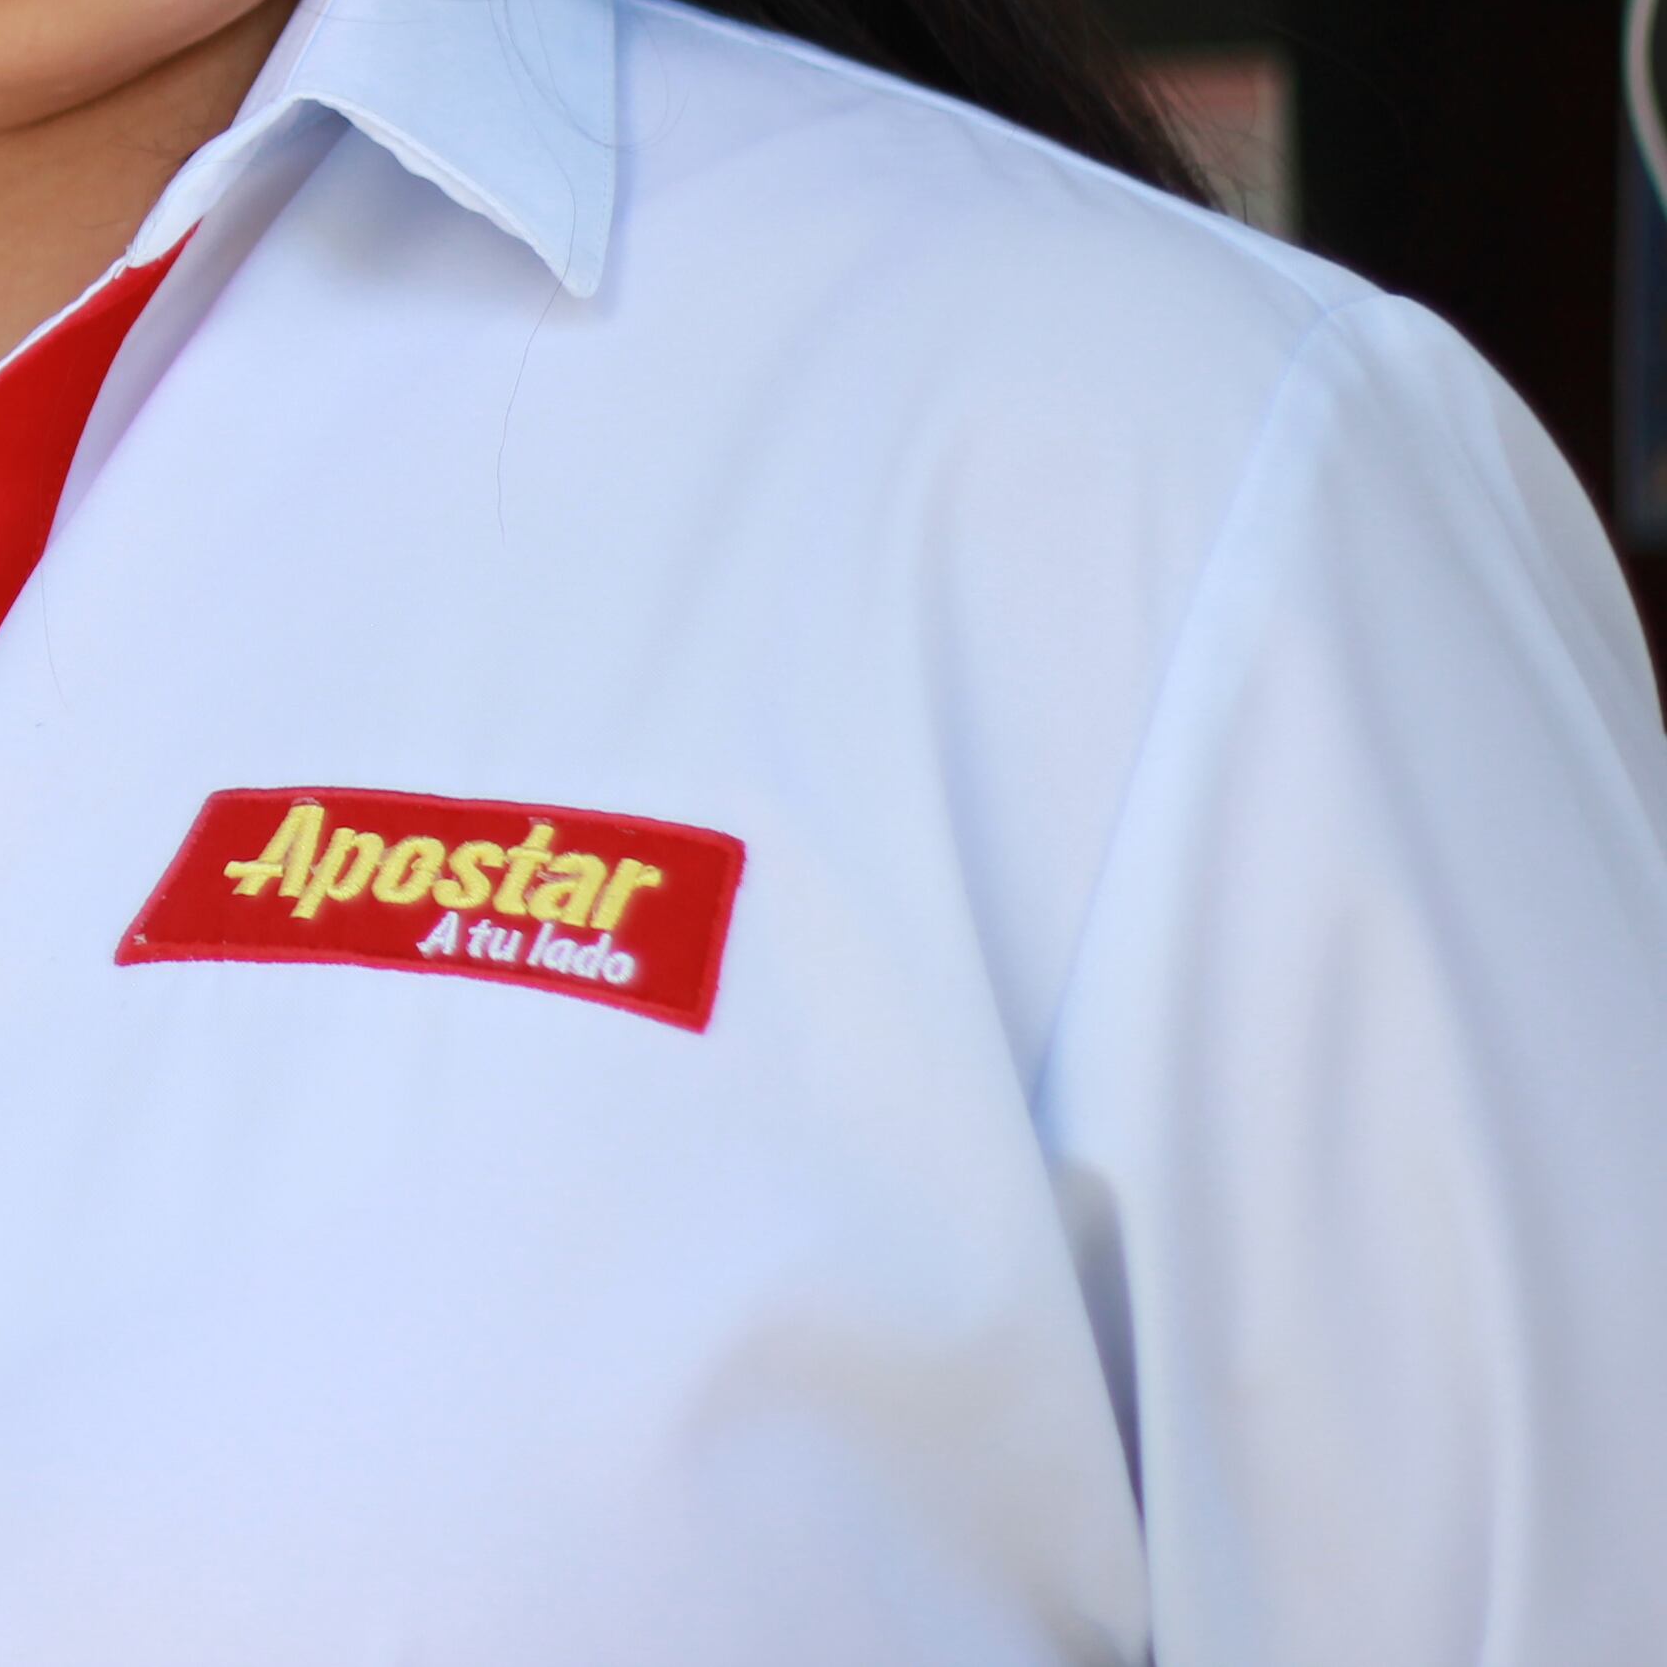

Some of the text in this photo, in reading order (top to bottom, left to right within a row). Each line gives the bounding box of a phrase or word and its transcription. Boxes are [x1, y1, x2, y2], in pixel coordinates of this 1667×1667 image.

[224, 803, 663, 931] Apostar
[416, 910, 636, 986] A tu lado
